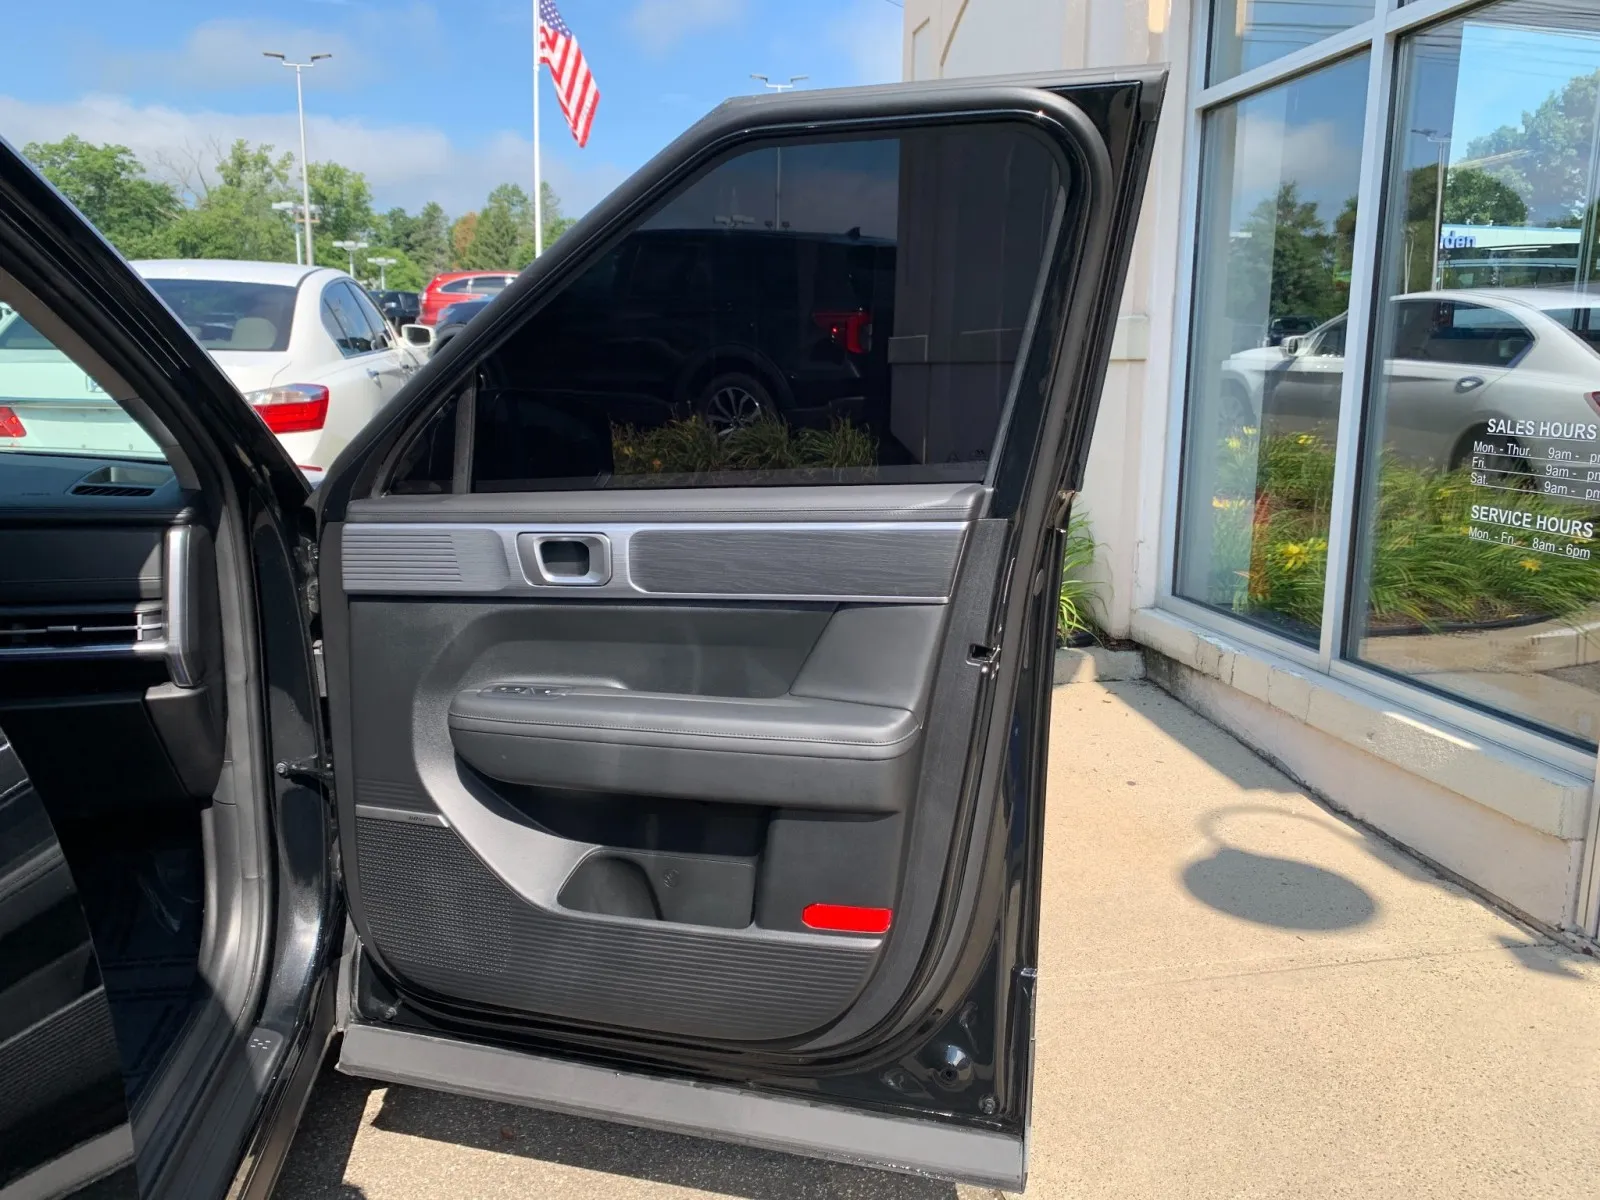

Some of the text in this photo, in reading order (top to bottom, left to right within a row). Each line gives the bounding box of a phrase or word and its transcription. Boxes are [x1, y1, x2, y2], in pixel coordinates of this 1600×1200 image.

[1487, 418, 1597, 440] SALES HOURS
[1473, 441, 1497, 454] Mon.
[1507, 443, 1532, 457] Thur.
[1548, 447, 1572, 461] 9am
[1472, 457, 1487, 469] Fri.
[1545, 465, 1569, 478] 9am
[1470, 472, 1489, 485] Sat.
[1544, 481, 1568, 495] 9am
[1471, 505, 1594, 538] SERVICE HOURS
[1468, 526, 1491, 541] Mon.
[1532, 538, 1555, 552] 8am
[1566, 544, 1591, 559] 6pm
